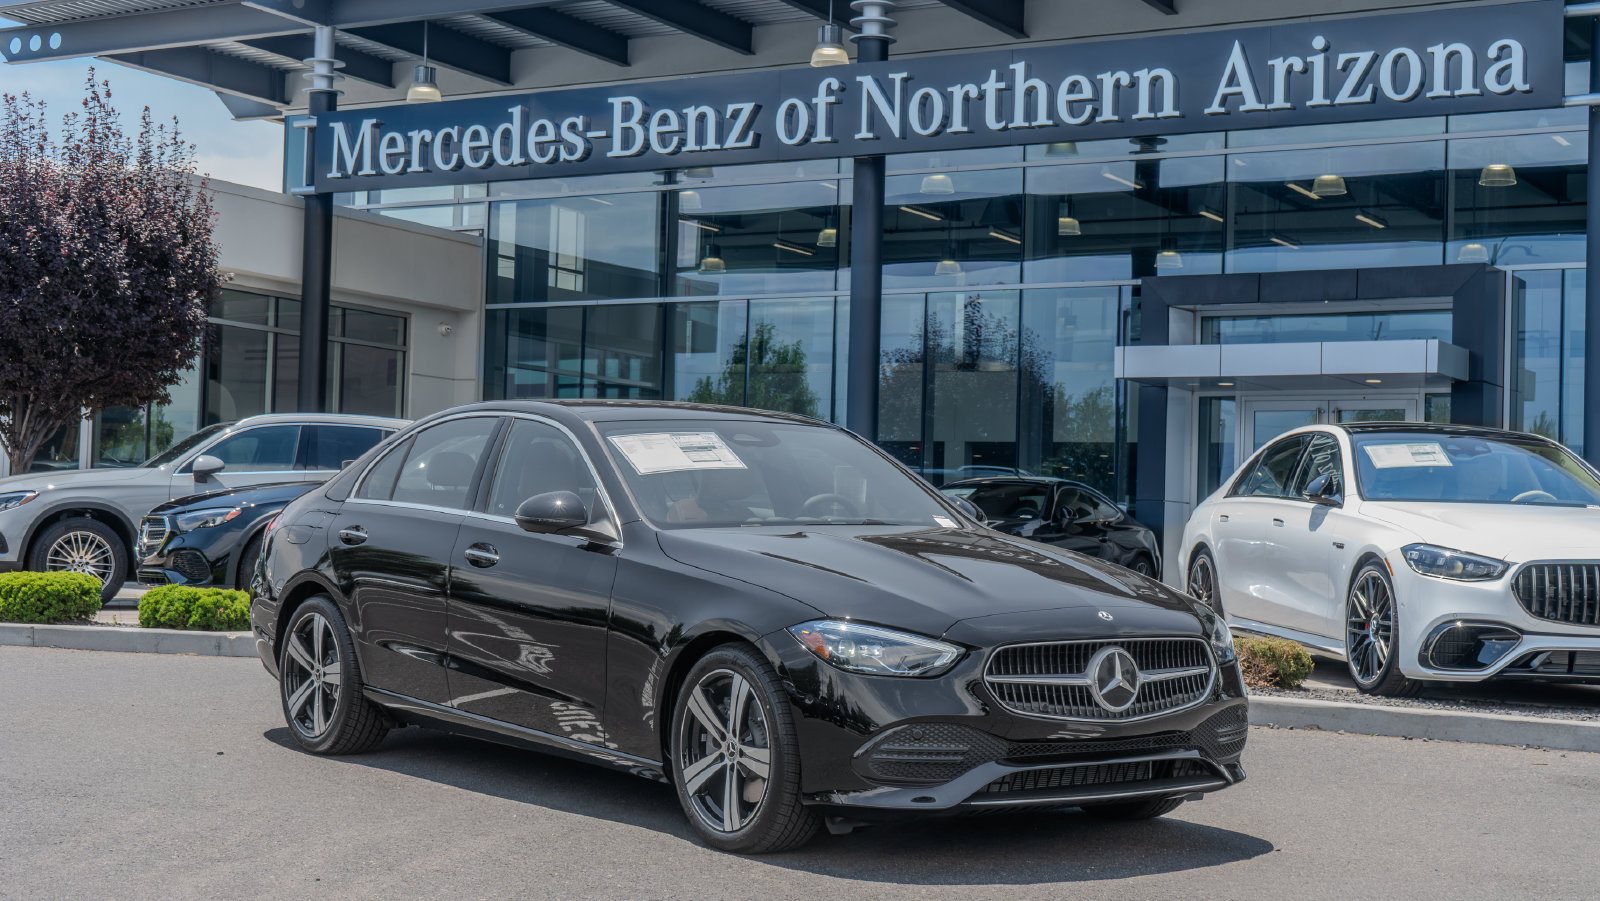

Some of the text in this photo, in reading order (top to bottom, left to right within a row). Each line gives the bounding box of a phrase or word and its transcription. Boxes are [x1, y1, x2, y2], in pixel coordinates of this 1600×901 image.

[327, 36, 1530, 178] Mercedes-Benz of Northern Arizona
